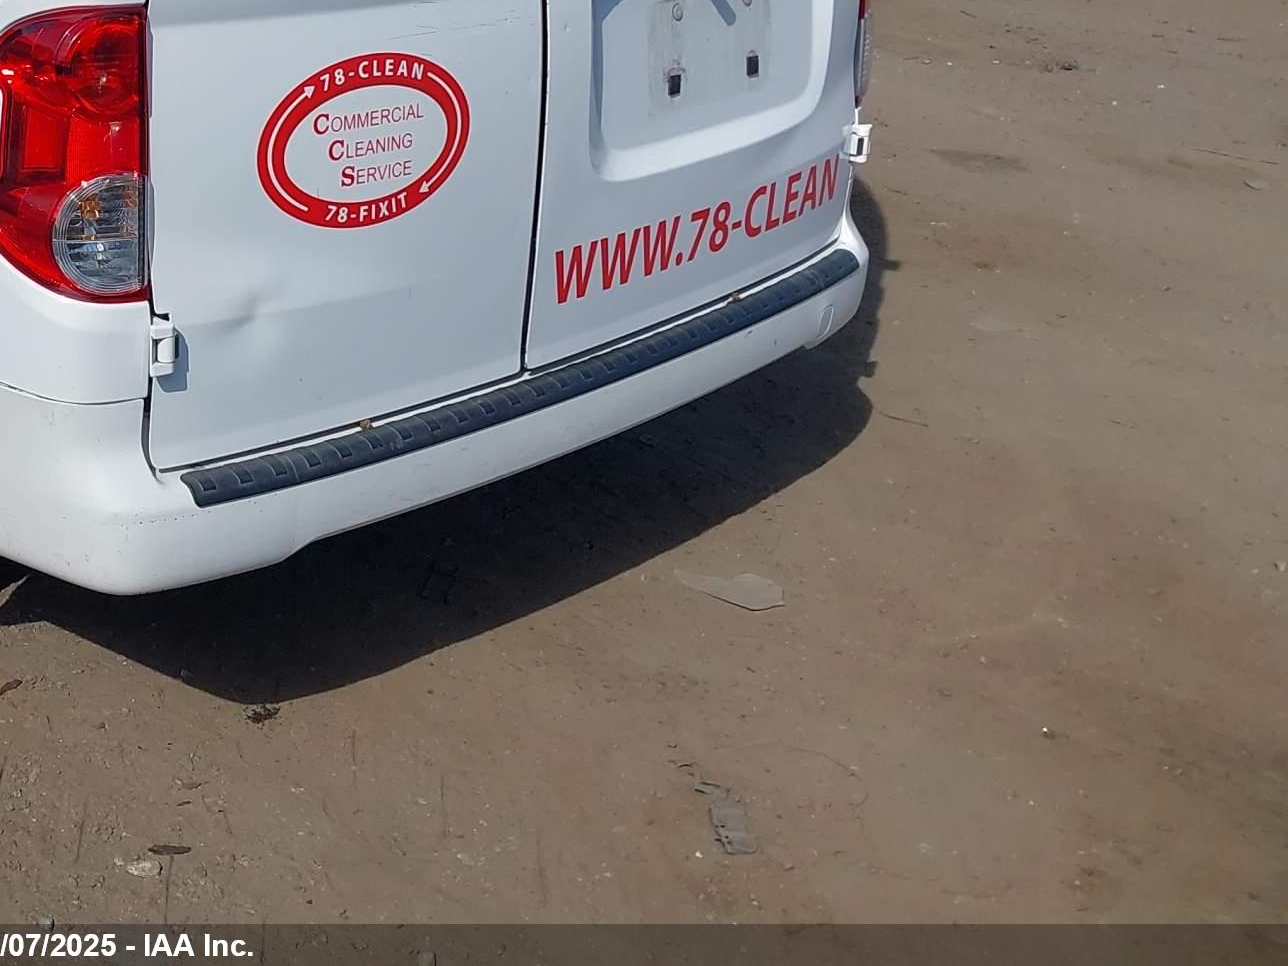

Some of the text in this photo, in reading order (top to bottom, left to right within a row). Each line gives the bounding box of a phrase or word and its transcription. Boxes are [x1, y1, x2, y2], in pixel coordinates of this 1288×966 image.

[320, 59, 425, 91] 78-CLEAN
[312, 103, 424, 135] COMMERCIAL
[328, 133, 413, 162] CLEANING
[340, 160, 413, 188] SERVICE
[324, 191, 408, 224] 78-FIXIT
[555, 154, 840, 305] WWW.78-CLEAN
